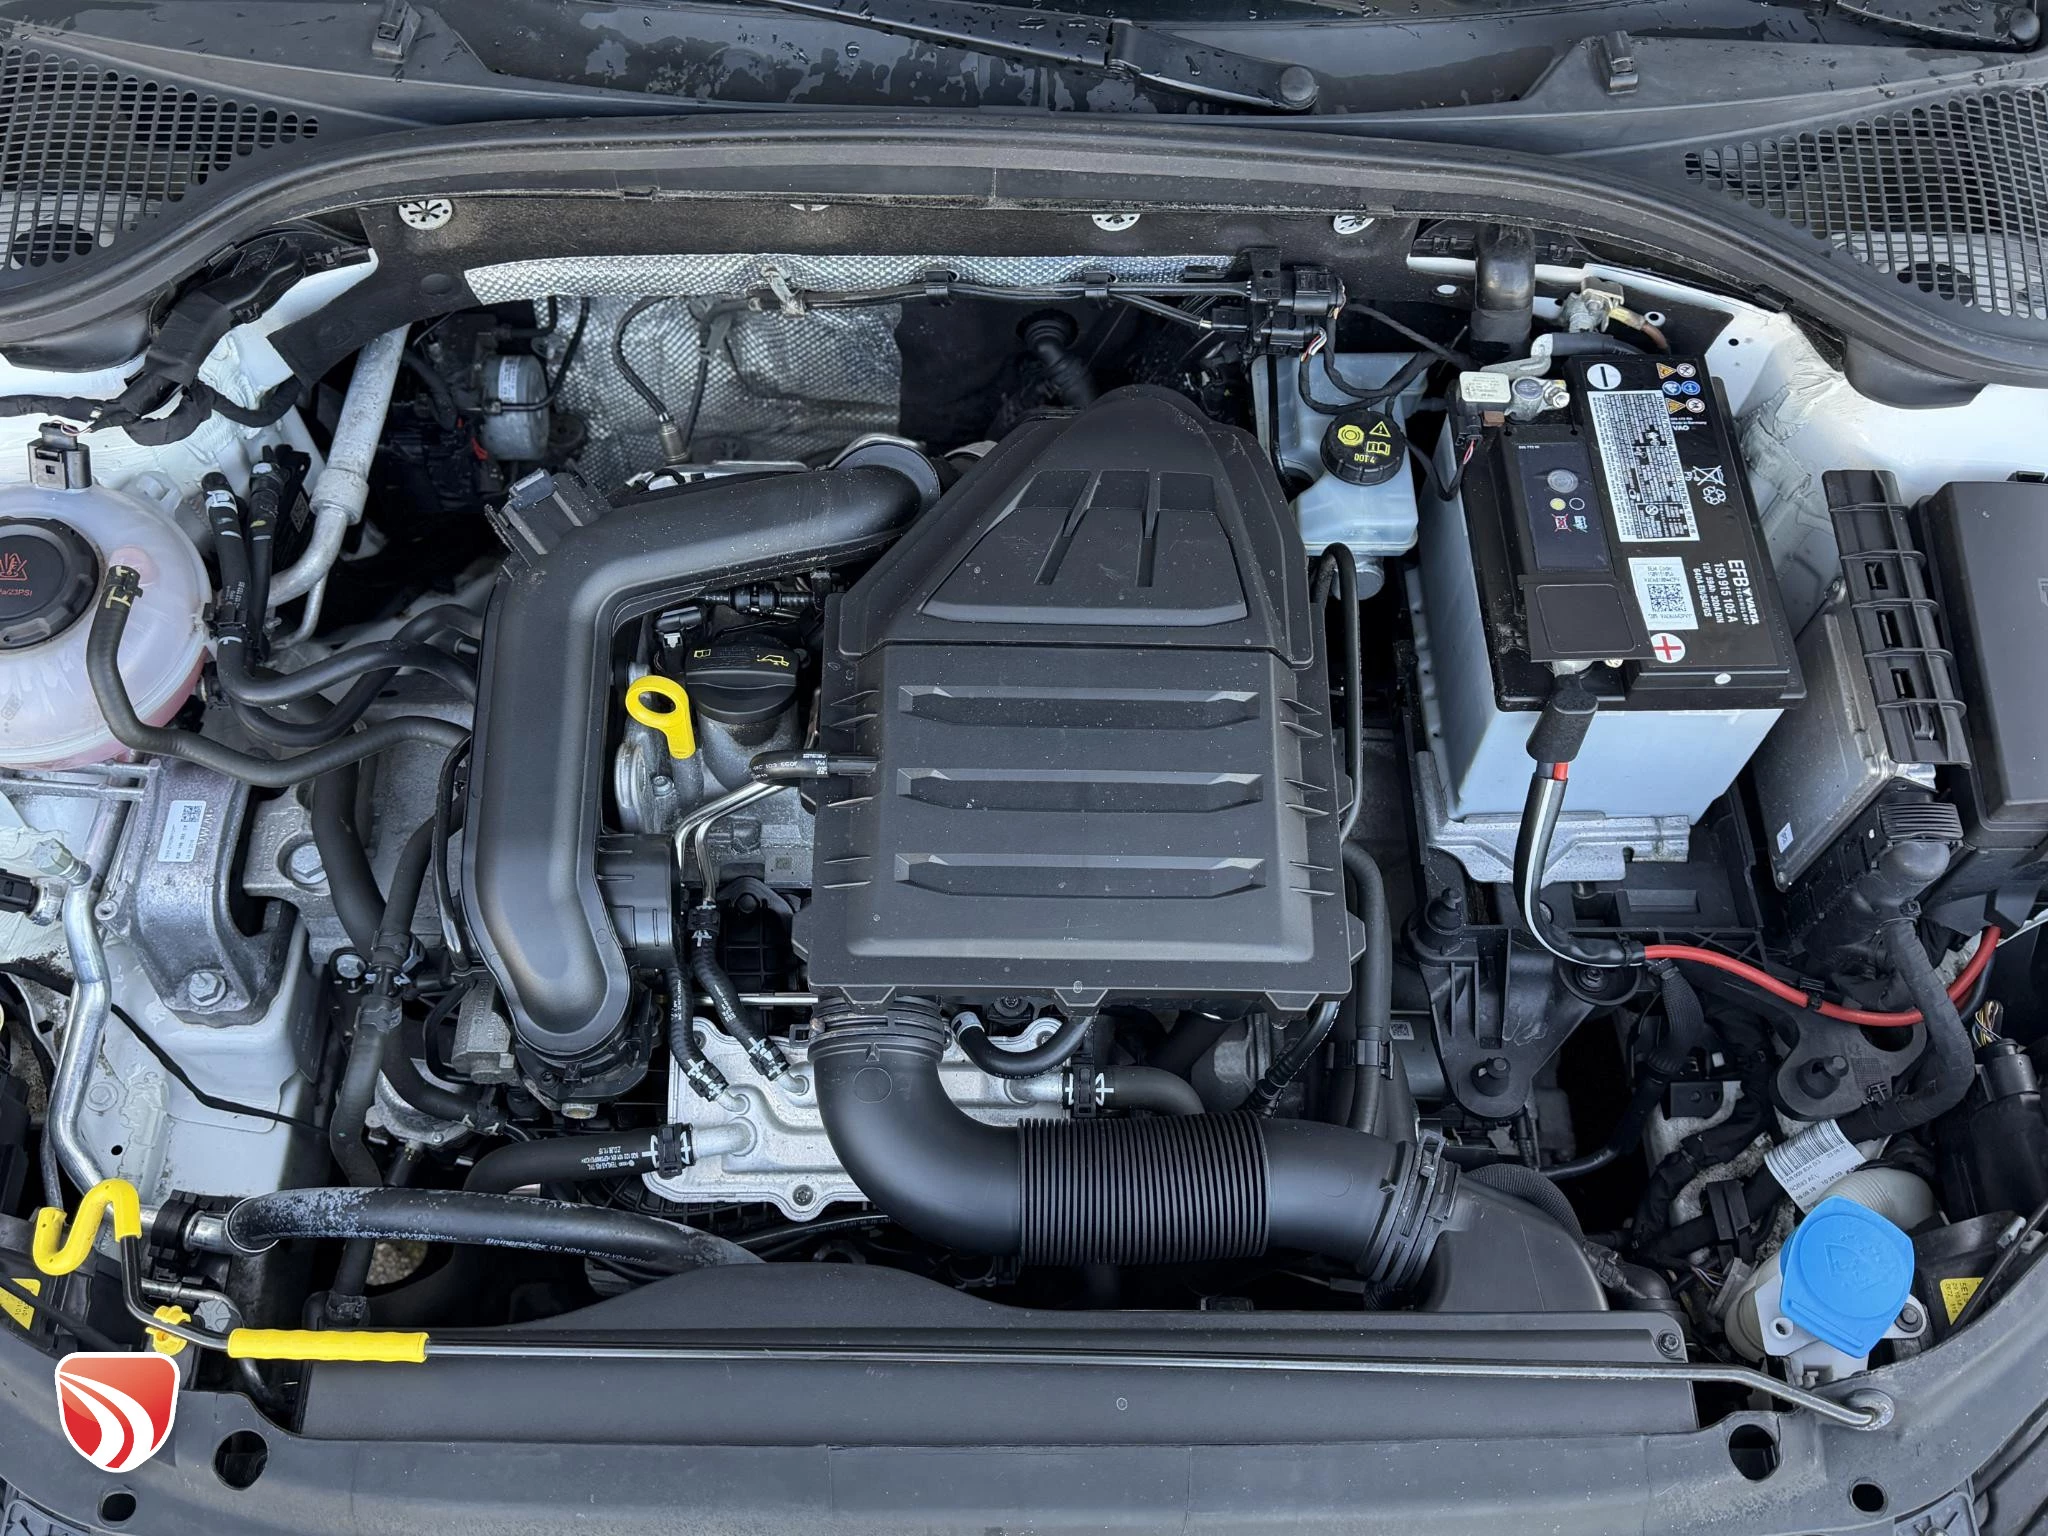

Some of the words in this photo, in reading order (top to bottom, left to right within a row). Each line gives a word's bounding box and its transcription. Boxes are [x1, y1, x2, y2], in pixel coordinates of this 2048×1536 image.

[1353, 453, 1370, 463] DOT
[1370, 456, 1376, 464] 4
[1702, 562, 1713, 574] 12V
[1714, 612, 1725, 624] DIN
[1718, 580, 1732, 596] 915
[1727, 559, 1750, 587] EFB
[1745, 596, 1760, 625] VARTA
[1722, 598, 1737, 615] 105
[1735, 587, 1750, 625] TECHNOLOGY
[1727, 615, 1739, 623] A
